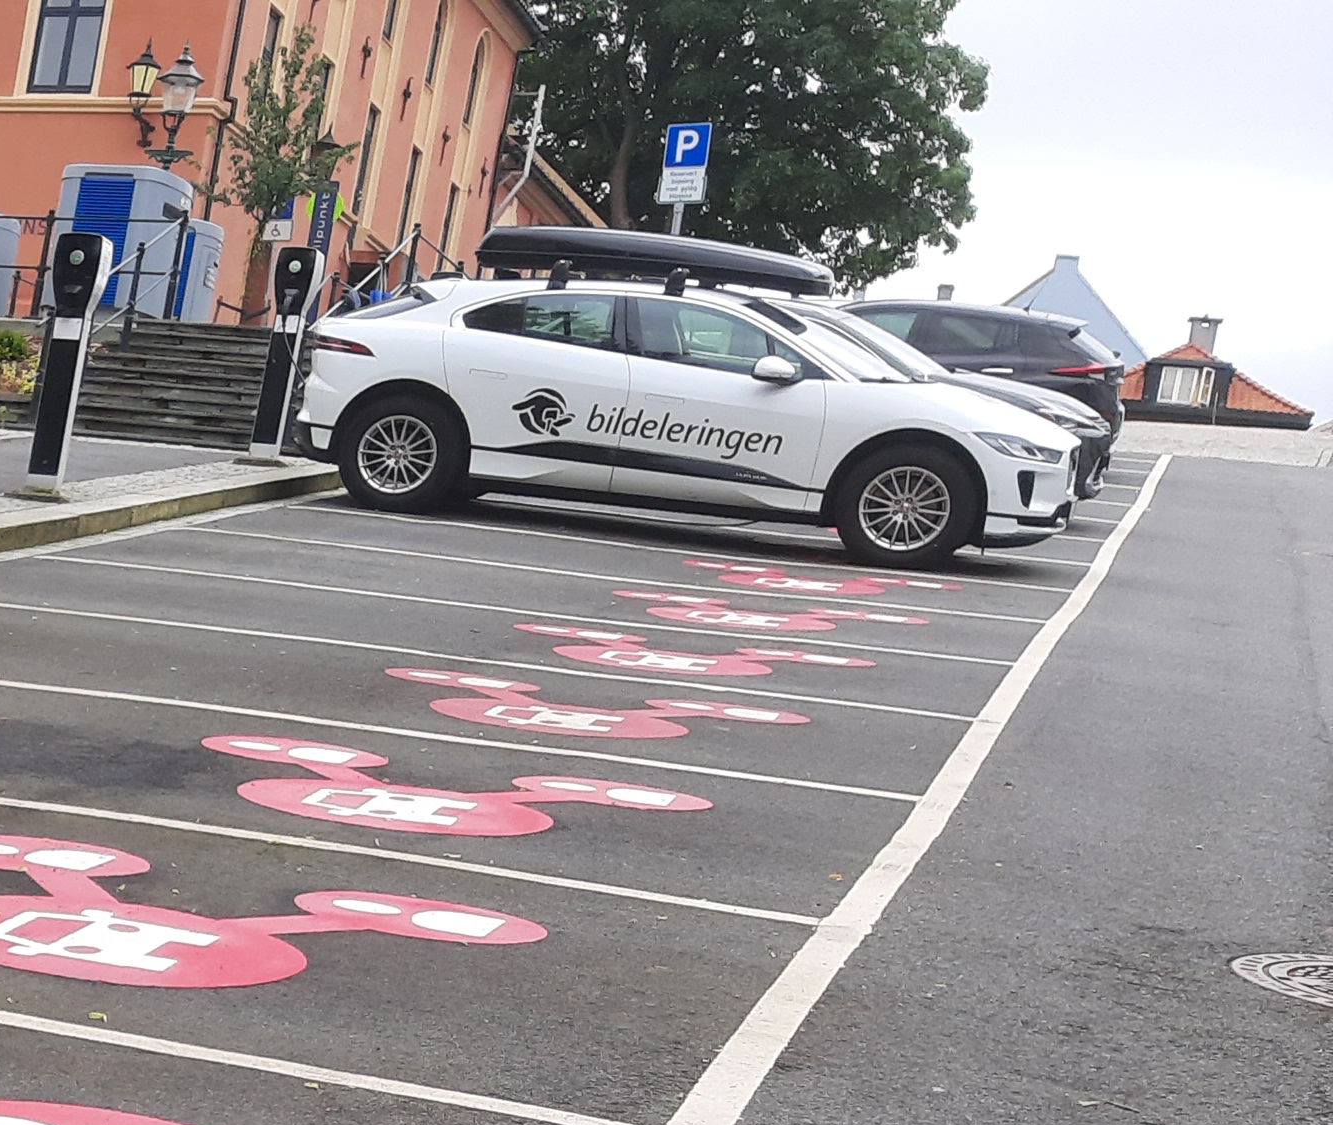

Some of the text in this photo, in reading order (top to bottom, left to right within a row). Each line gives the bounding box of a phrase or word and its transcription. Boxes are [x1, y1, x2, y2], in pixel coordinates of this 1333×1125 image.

[675, 129, 700, 163] P
[20, 219, 48, 236] NS
[585, 403, 784, 460] bildeleringen
